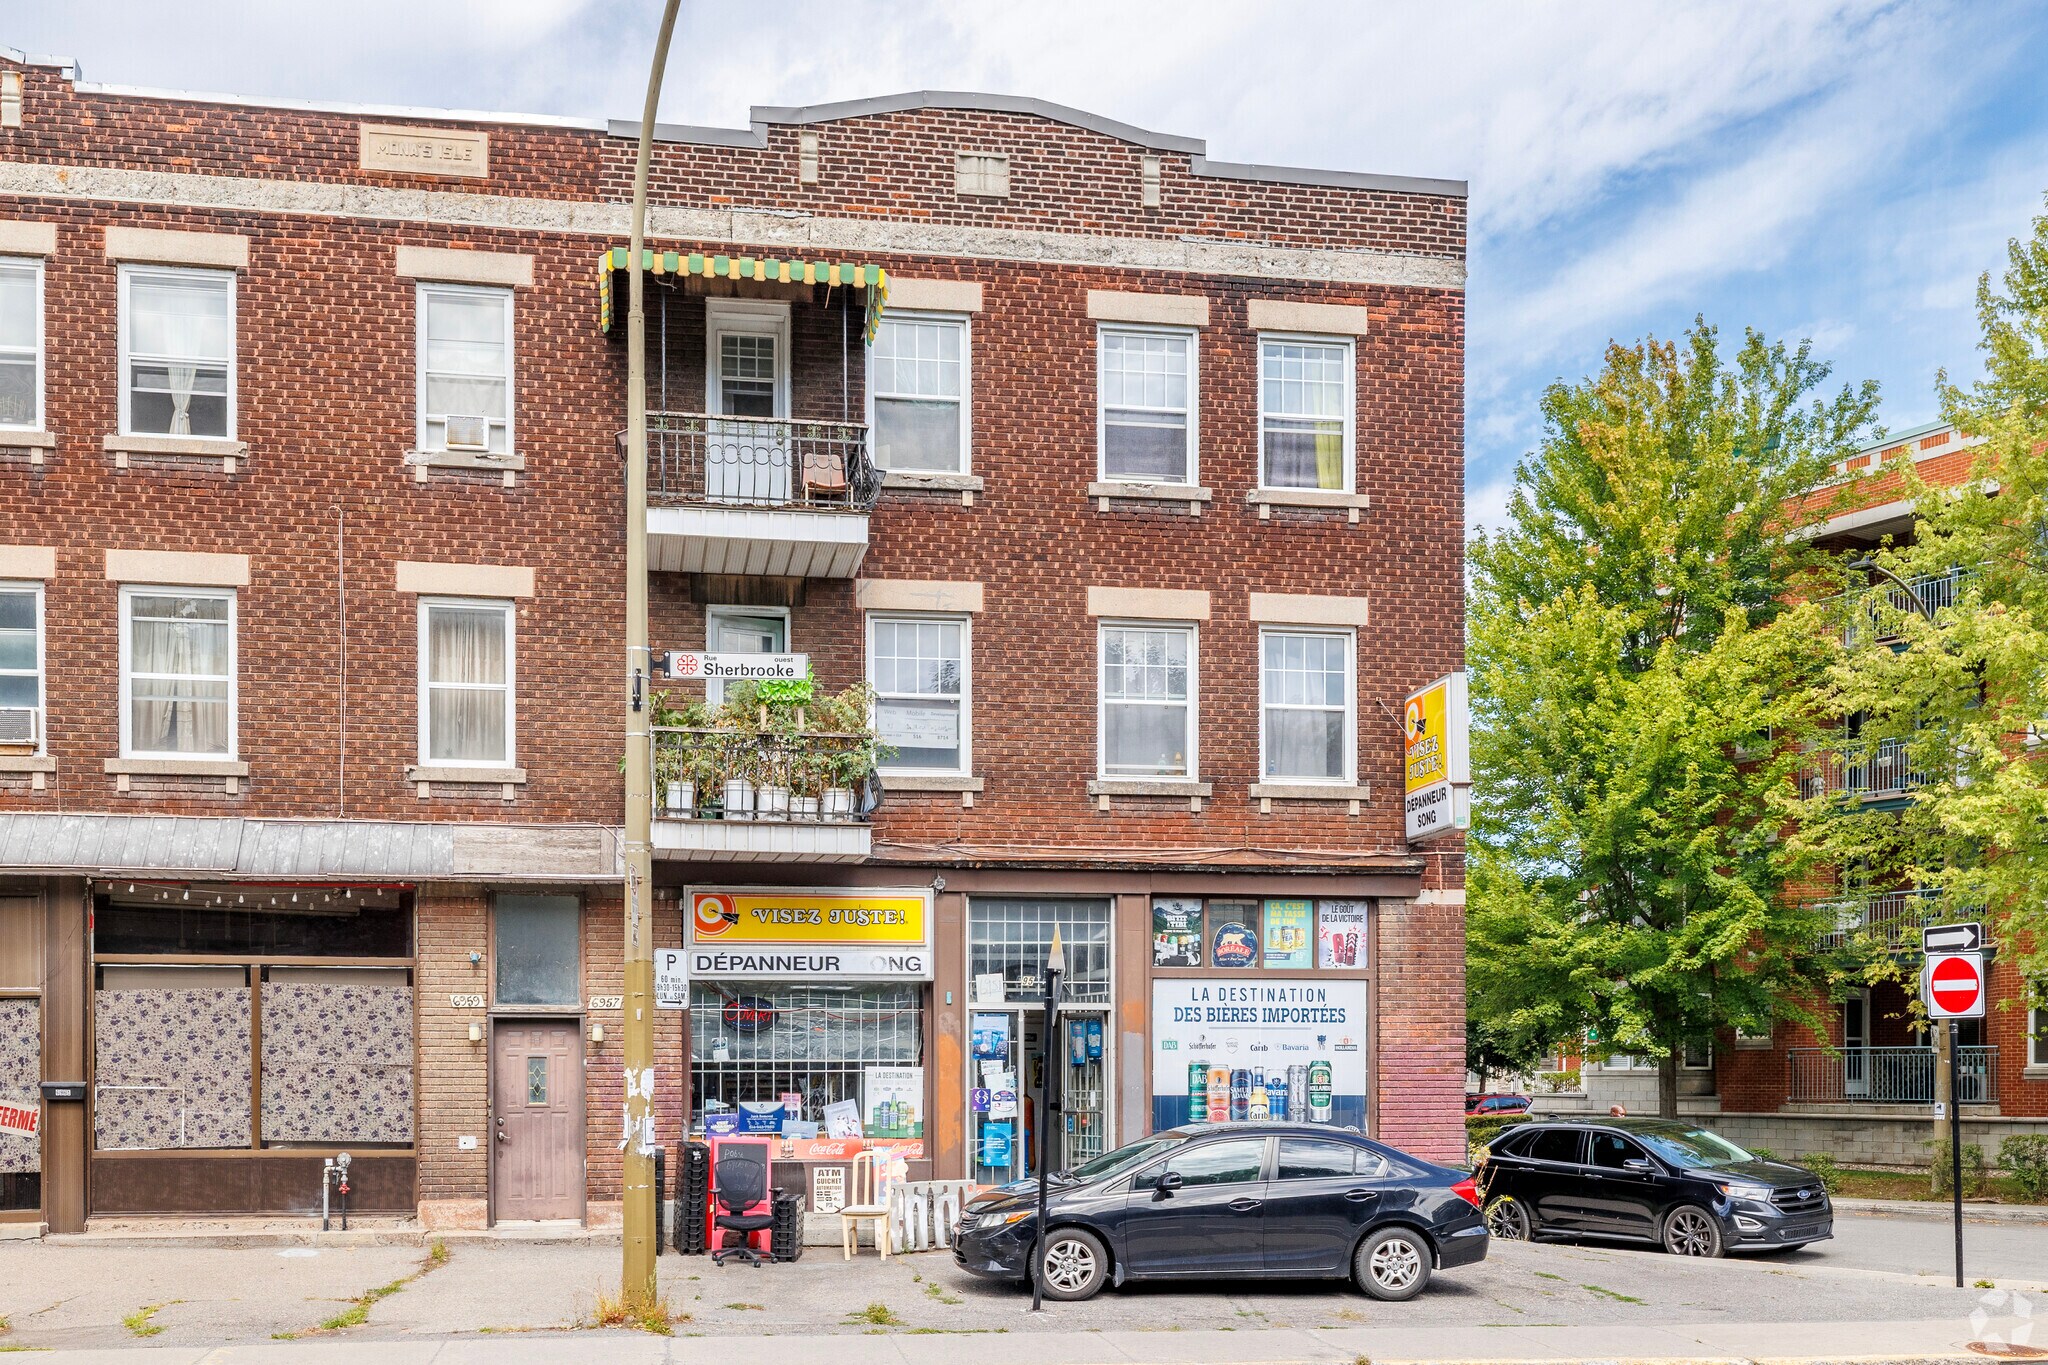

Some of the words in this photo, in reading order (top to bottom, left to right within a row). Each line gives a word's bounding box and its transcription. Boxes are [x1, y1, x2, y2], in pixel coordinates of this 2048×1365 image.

[704, 654, 717, 662] Rue
[703, 662, 795, 678] Sherbrooke
[1409, 734, 1440, 761] VISEZ
[1408, 753, 1443, 781] JUSTE!
[1406, 786, 1447, 813] DÉPANNEUR
[1417, 809, 1437, 828] SONG
[1331, 905, 1339, 913] LE
[751, 907, 823, 925] VISEZ
[828, 908, 906, 927] JUSTE!
[1321, 914, 1330, 923] DE
[1330, 914, 1338, 923] LA
[1338, 914, 1364, 923] VICTOIRE
[667, 954, 677, 971] P
[696, 952, 841, 972] DÉPANNEUR
[660, 974, 669, 983] 60
[656, 983, 688, 992] 9h30-15h30
[452, 995, 480, 1007] 6959
[1191, 987, 1210, 1002] LA
[1218, 987, 1327, 1003] DESTINATION
[591, 996, 620, 1008] 6957
[1173, 1006, 1202, 1023] DES
[1206, 1003, 1258, 1023] BIÈRES
[1262, 1004, 1346, 1024] IMPORTÉES
[1163, 1041, 1177, 1049] DAB
[883, 1072, 913, 1080] DESTINATION
[1192, 1074, 1207, 1085] DAB
[1250, 1111, 1269, 1121] Carib
[817, 1169, 841, 1177] ATM
[816, 1177, 842, 1185] GUICHET
